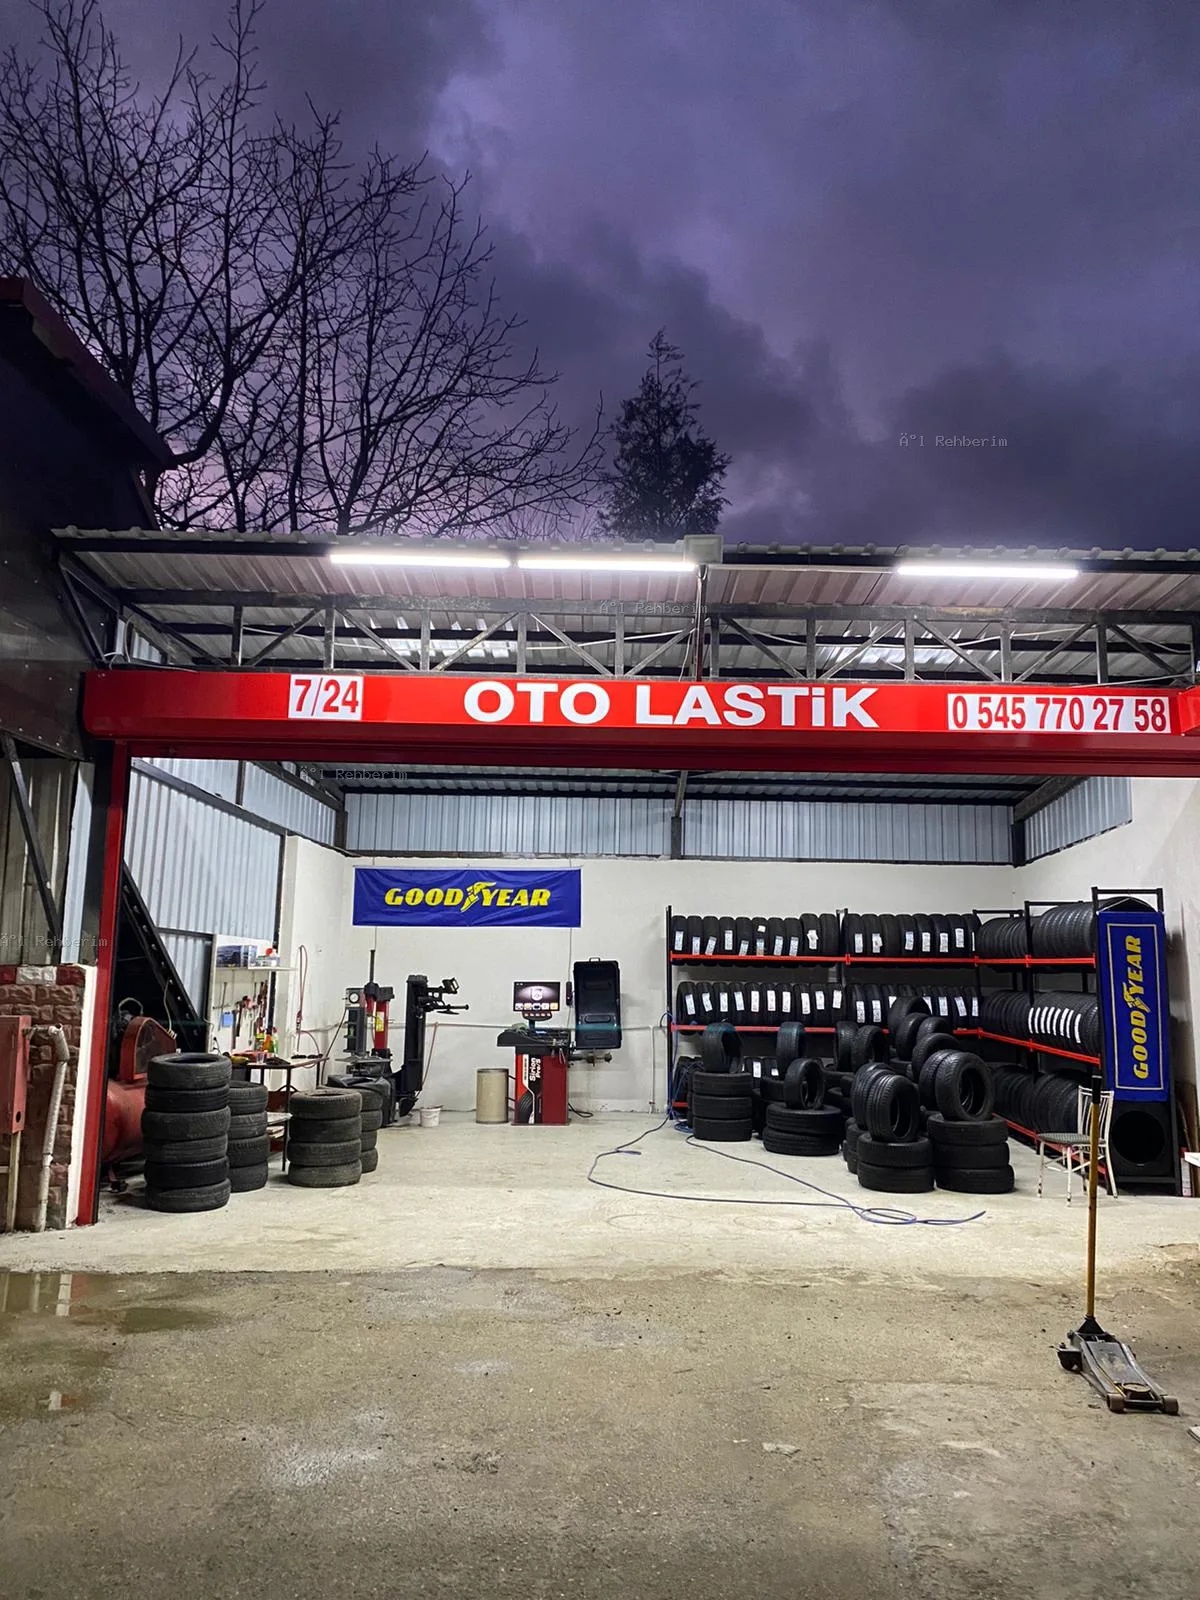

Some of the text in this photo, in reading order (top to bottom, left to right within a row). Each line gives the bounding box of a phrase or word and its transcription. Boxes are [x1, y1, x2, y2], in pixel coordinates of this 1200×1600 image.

[294, 677, 359, 717] 7/24
[463, 681, 611, 724] OTO
[952, 695, 1167, 732] 0 545 770 27 58
